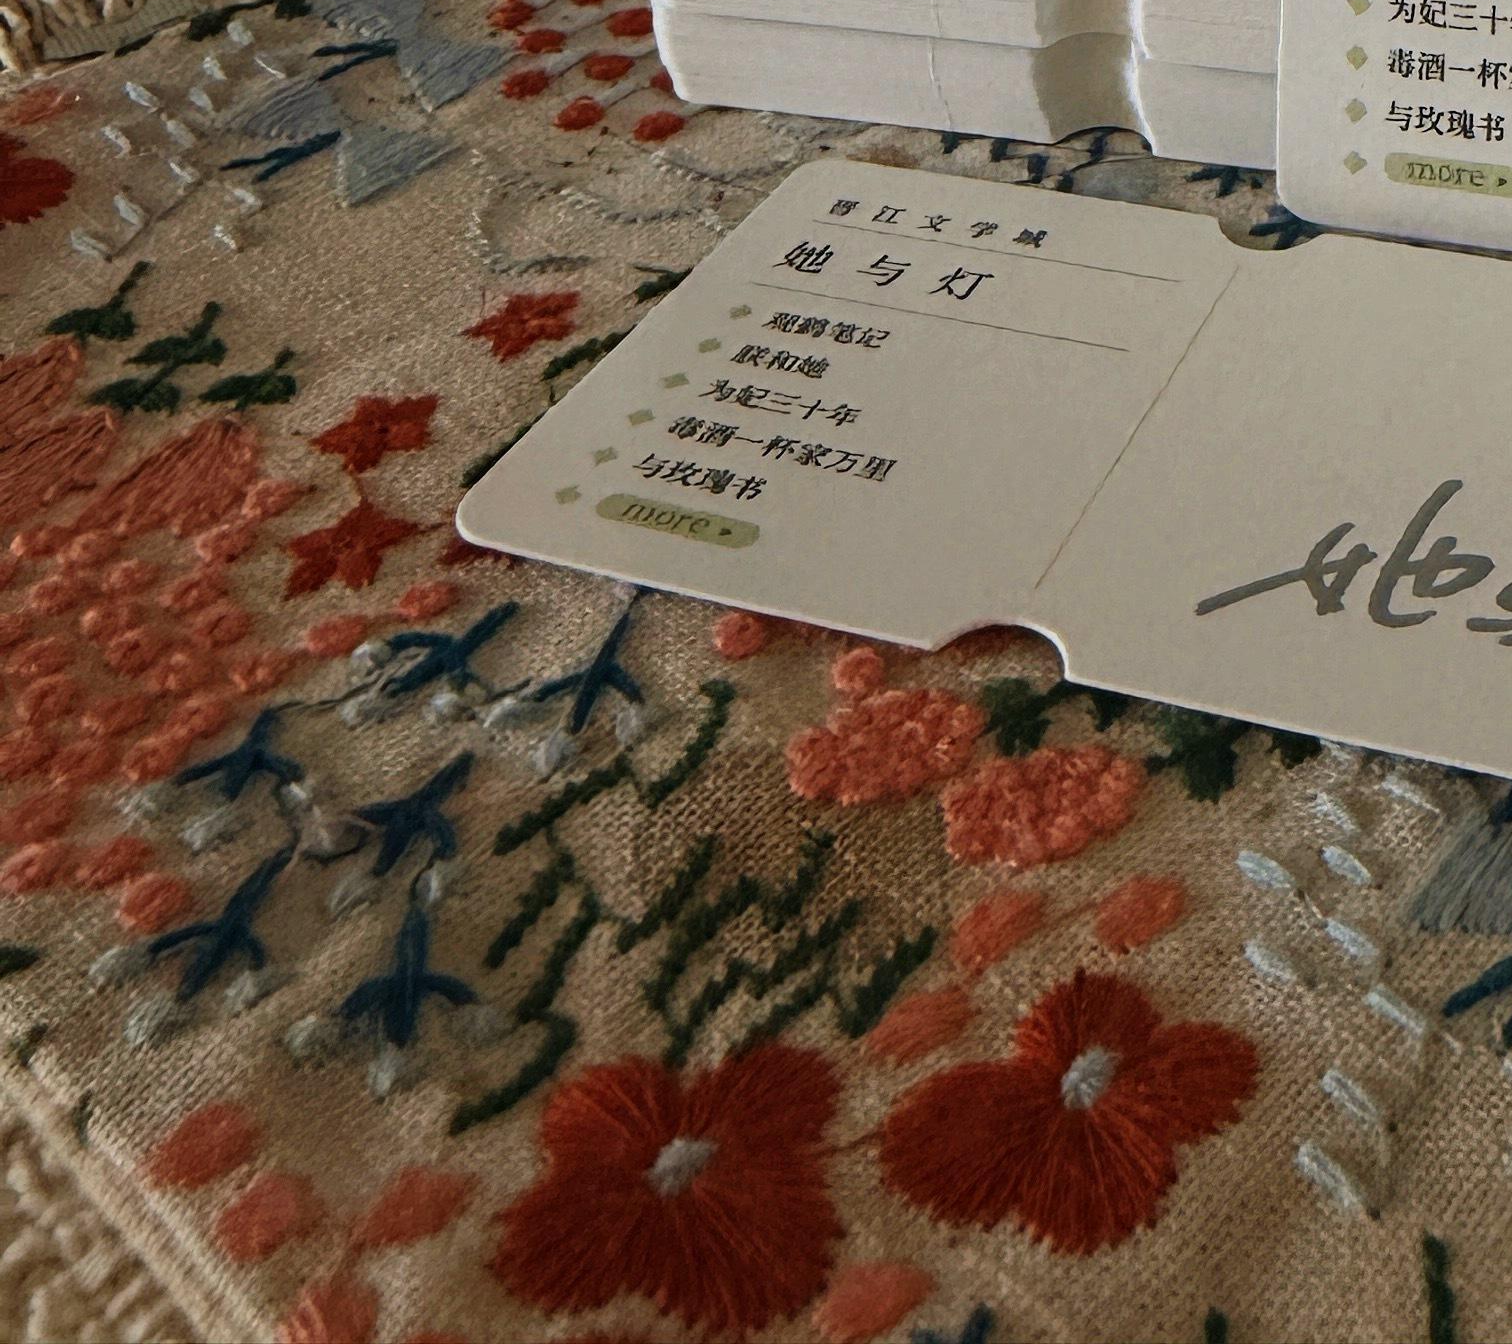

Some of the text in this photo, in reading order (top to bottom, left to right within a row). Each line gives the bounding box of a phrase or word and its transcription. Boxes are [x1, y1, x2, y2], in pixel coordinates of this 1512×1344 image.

[1384, 99, 1506, 142] 与玫瑰书
[1404, 160, 1487, 188] more
[772, 239, 996, 301] 她与灯
[619, 499, 712, 538] more
